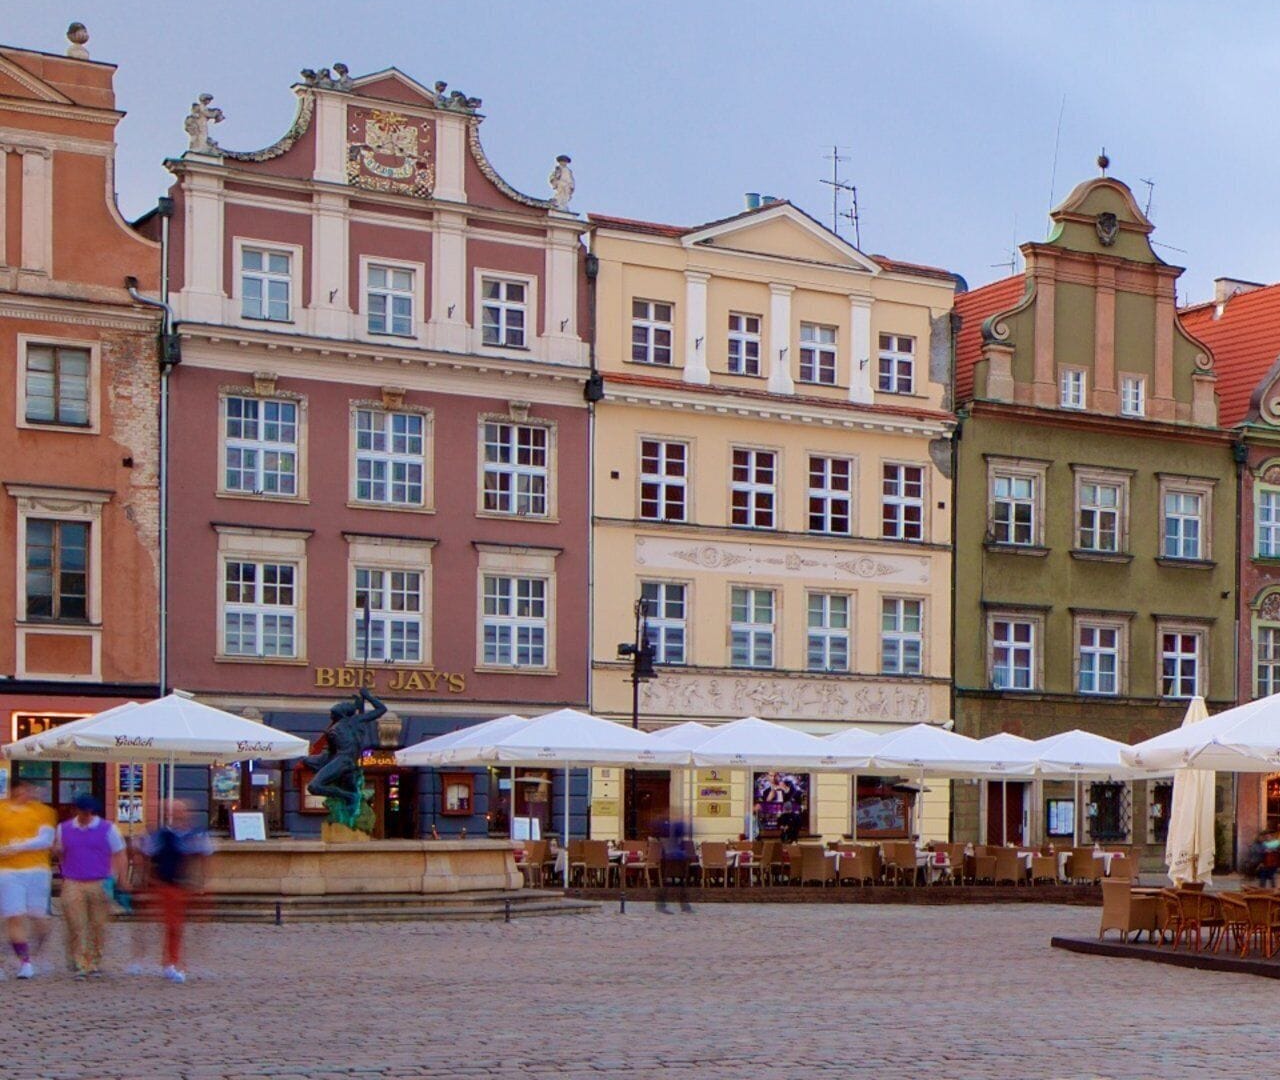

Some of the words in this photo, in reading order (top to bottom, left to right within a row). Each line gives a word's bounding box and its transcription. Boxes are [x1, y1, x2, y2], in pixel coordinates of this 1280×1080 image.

[314, 667, 376, 689] BEE
[389, 670, 465, 693] JAY'S
[114, 735, 154, 748] Grolsch
[236, 740, 274, 753] Grolsch
